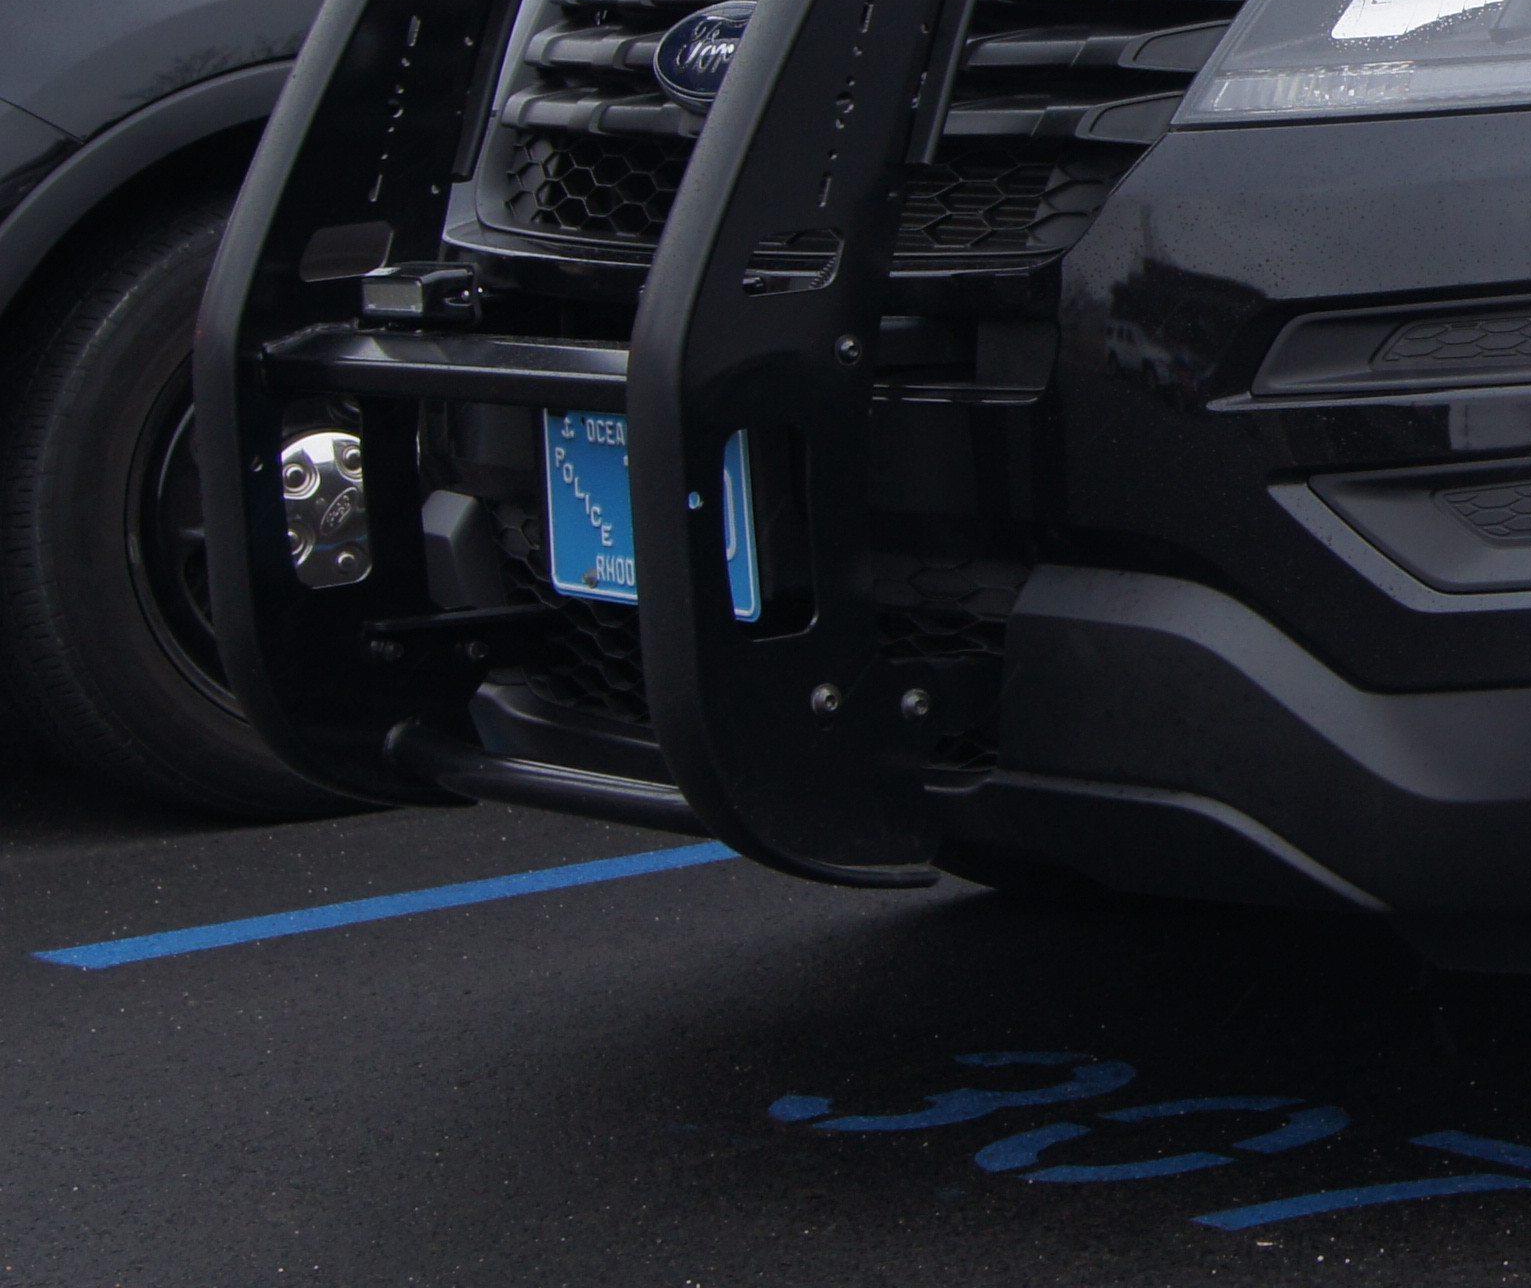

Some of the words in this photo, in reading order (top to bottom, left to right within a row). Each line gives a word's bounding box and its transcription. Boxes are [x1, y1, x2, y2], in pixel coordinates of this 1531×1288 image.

[586, 418, 626, 446] OCEA
[555, 447, 613, 546] POLICE
[596, 555, 635, 587] RHOD
